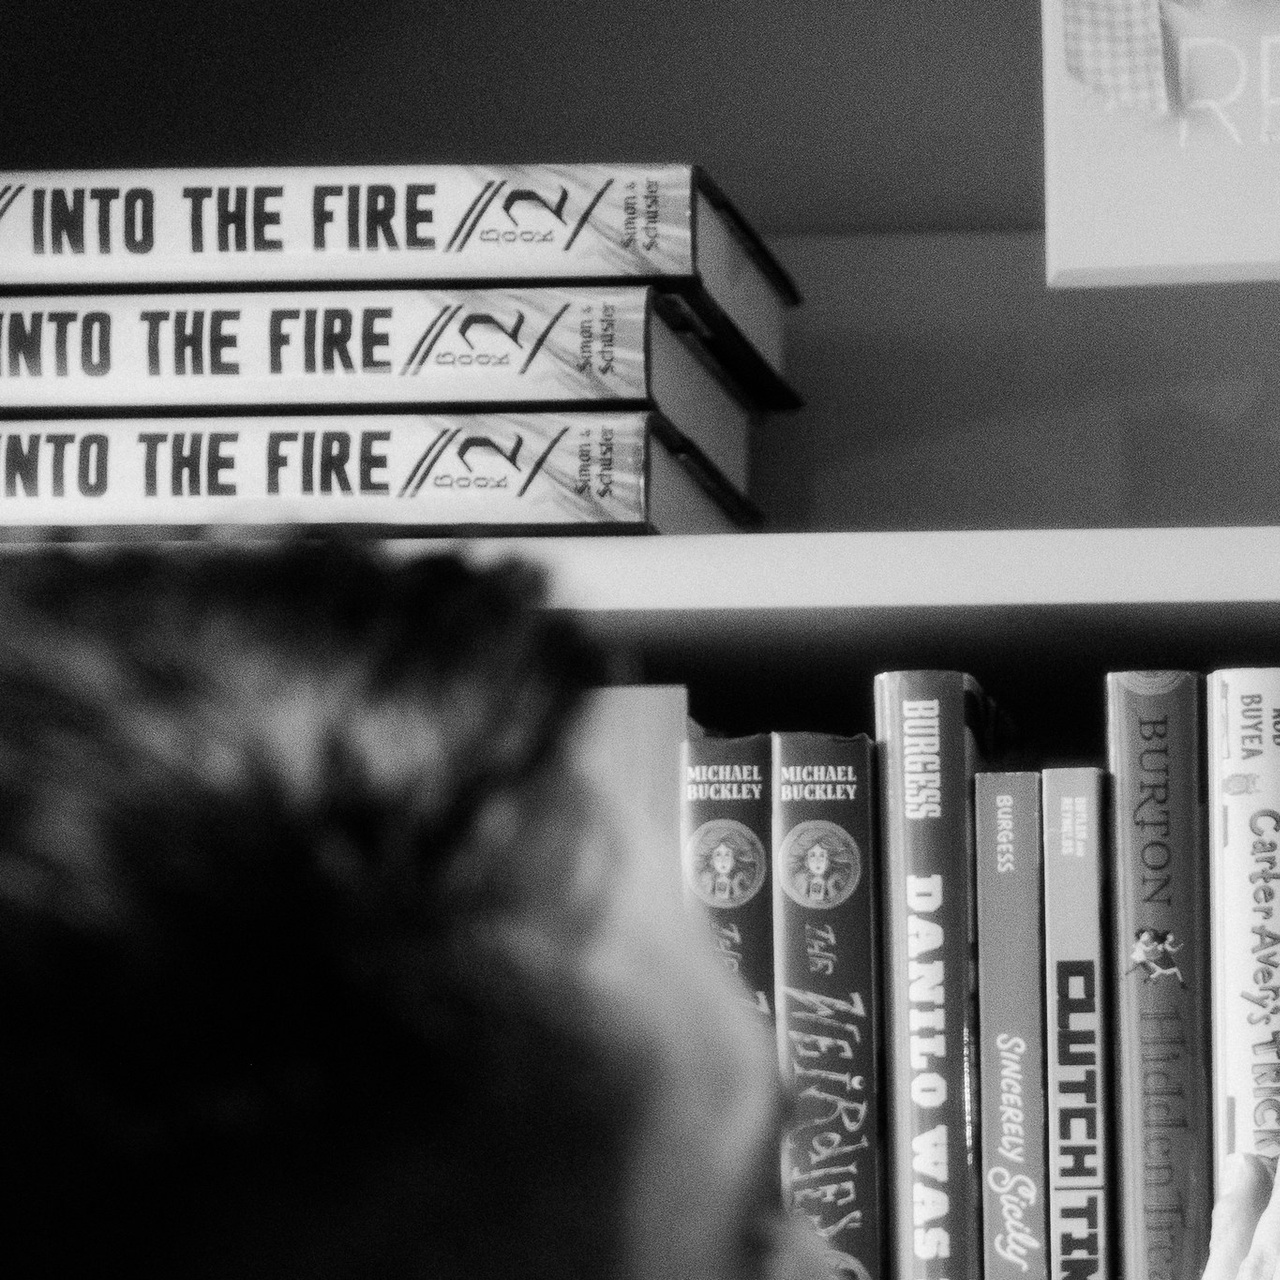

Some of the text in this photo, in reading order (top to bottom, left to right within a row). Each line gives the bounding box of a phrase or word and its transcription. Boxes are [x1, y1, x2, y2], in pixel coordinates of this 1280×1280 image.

[32, 184, 436, 253] INTO THE FIRE
[141, 308, 392, 376] THE FIRE
[138, 431, 390, 497] THE FIRE
[903, 700, 942, 819] BURGESS
[1241, 693, 1263, 760] BUYEA
[687, 766, 762, 782] MICHAEL
[687, 784, 762, 800] BUCKLEY
[781, 766, 856, 782] MICHAEL
[781, 784, 857, 800] BUCKLEY
[996, 794, 1014, 873] BURGESS
[1134, 715, 1171, 905] BURTON
[906, 874, 948, 1107] DANILO
[1057, 960, 1097, 1177] CLUTCH
[987, 1034, 1041, 1270] SINCERELY Sicily
[912, 1125, 950, 1259] WAS
